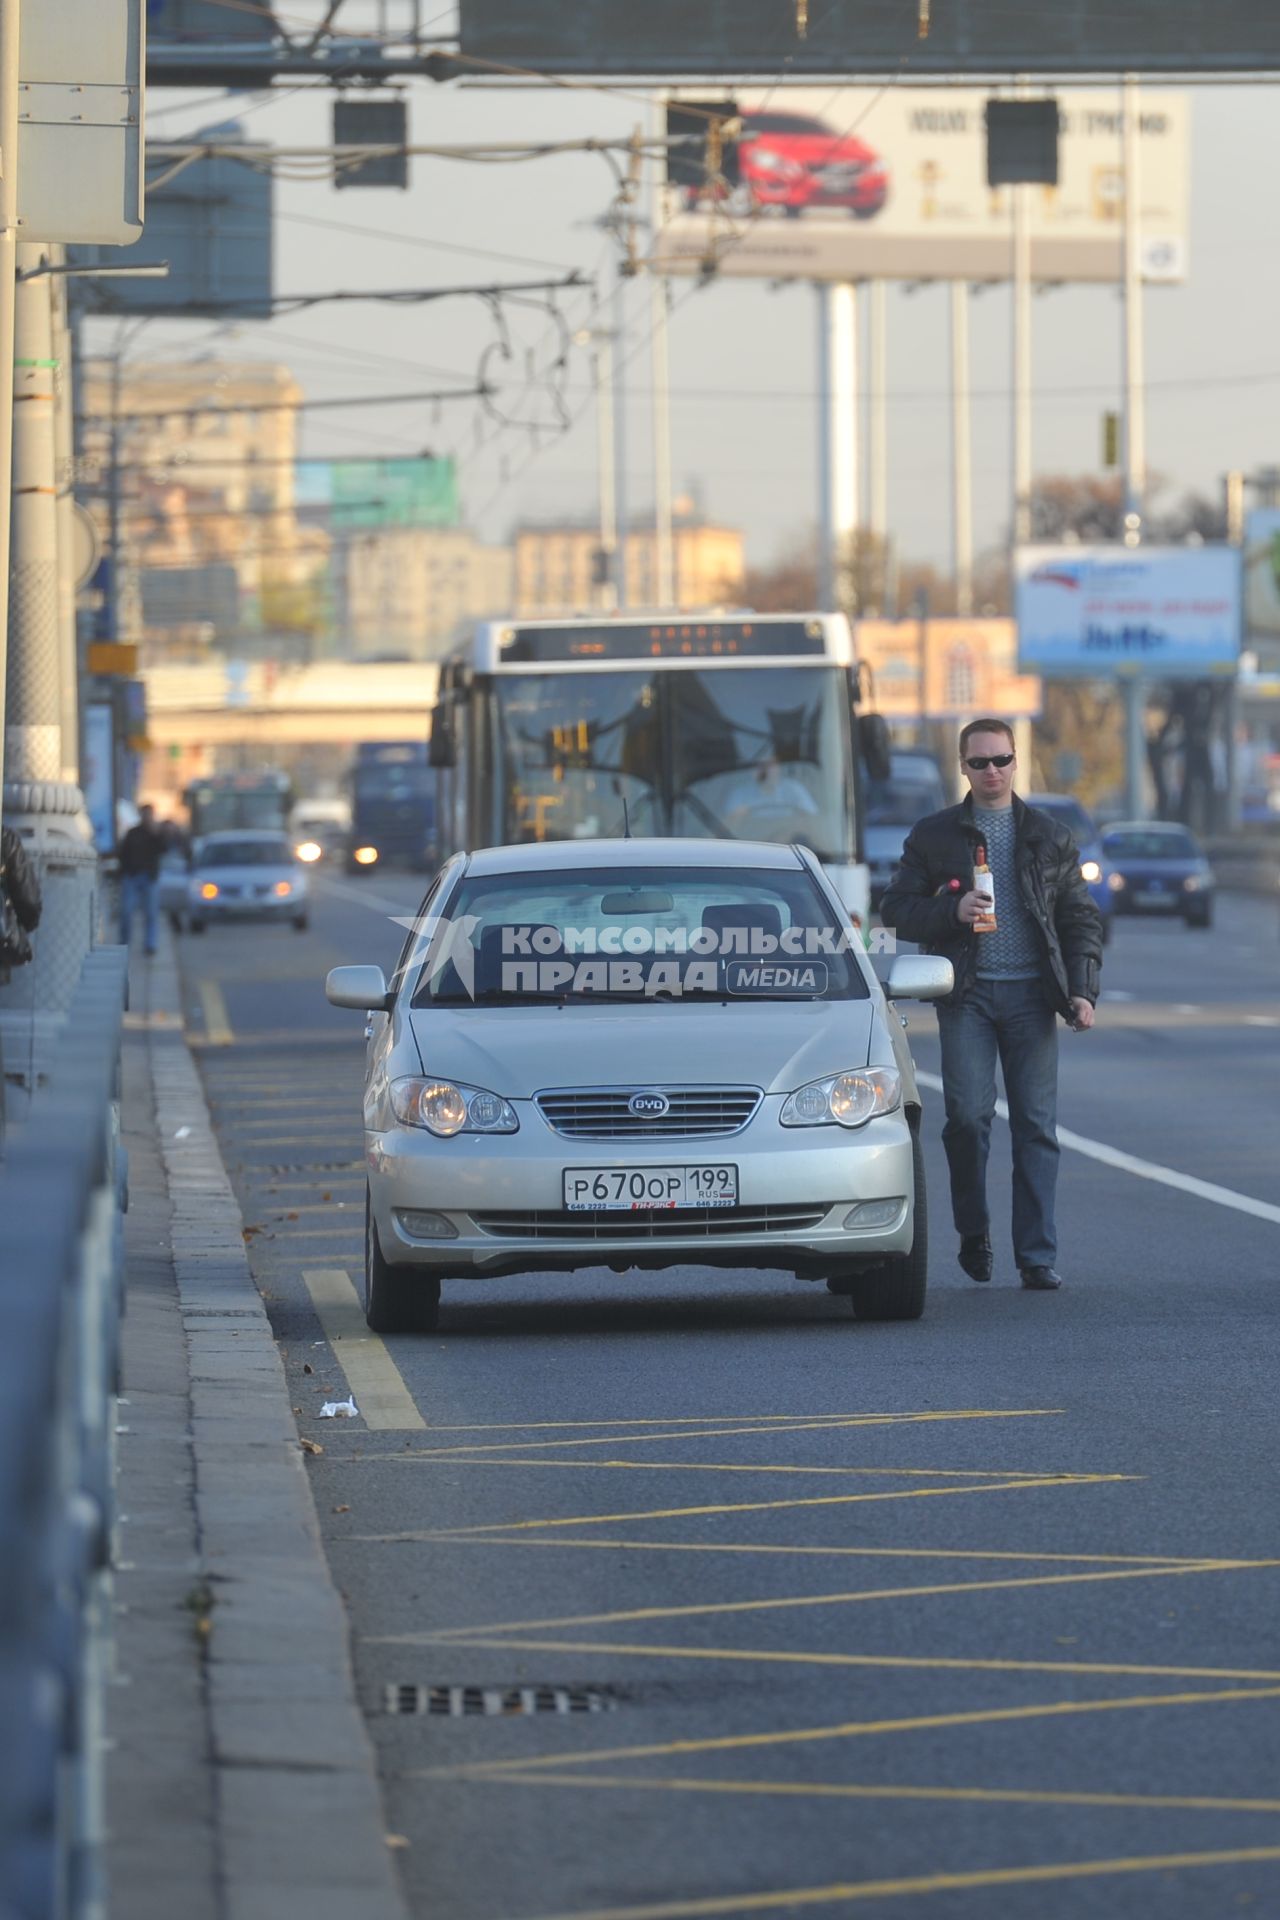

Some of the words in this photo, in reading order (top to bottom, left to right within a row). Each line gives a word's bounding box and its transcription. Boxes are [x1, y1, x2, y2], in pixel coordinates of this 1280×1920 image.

[635, 1099, 663, 1110] BYD
[689, 1169, 729, 1190] 199
[698, 1190, 719, 1198] RUS
